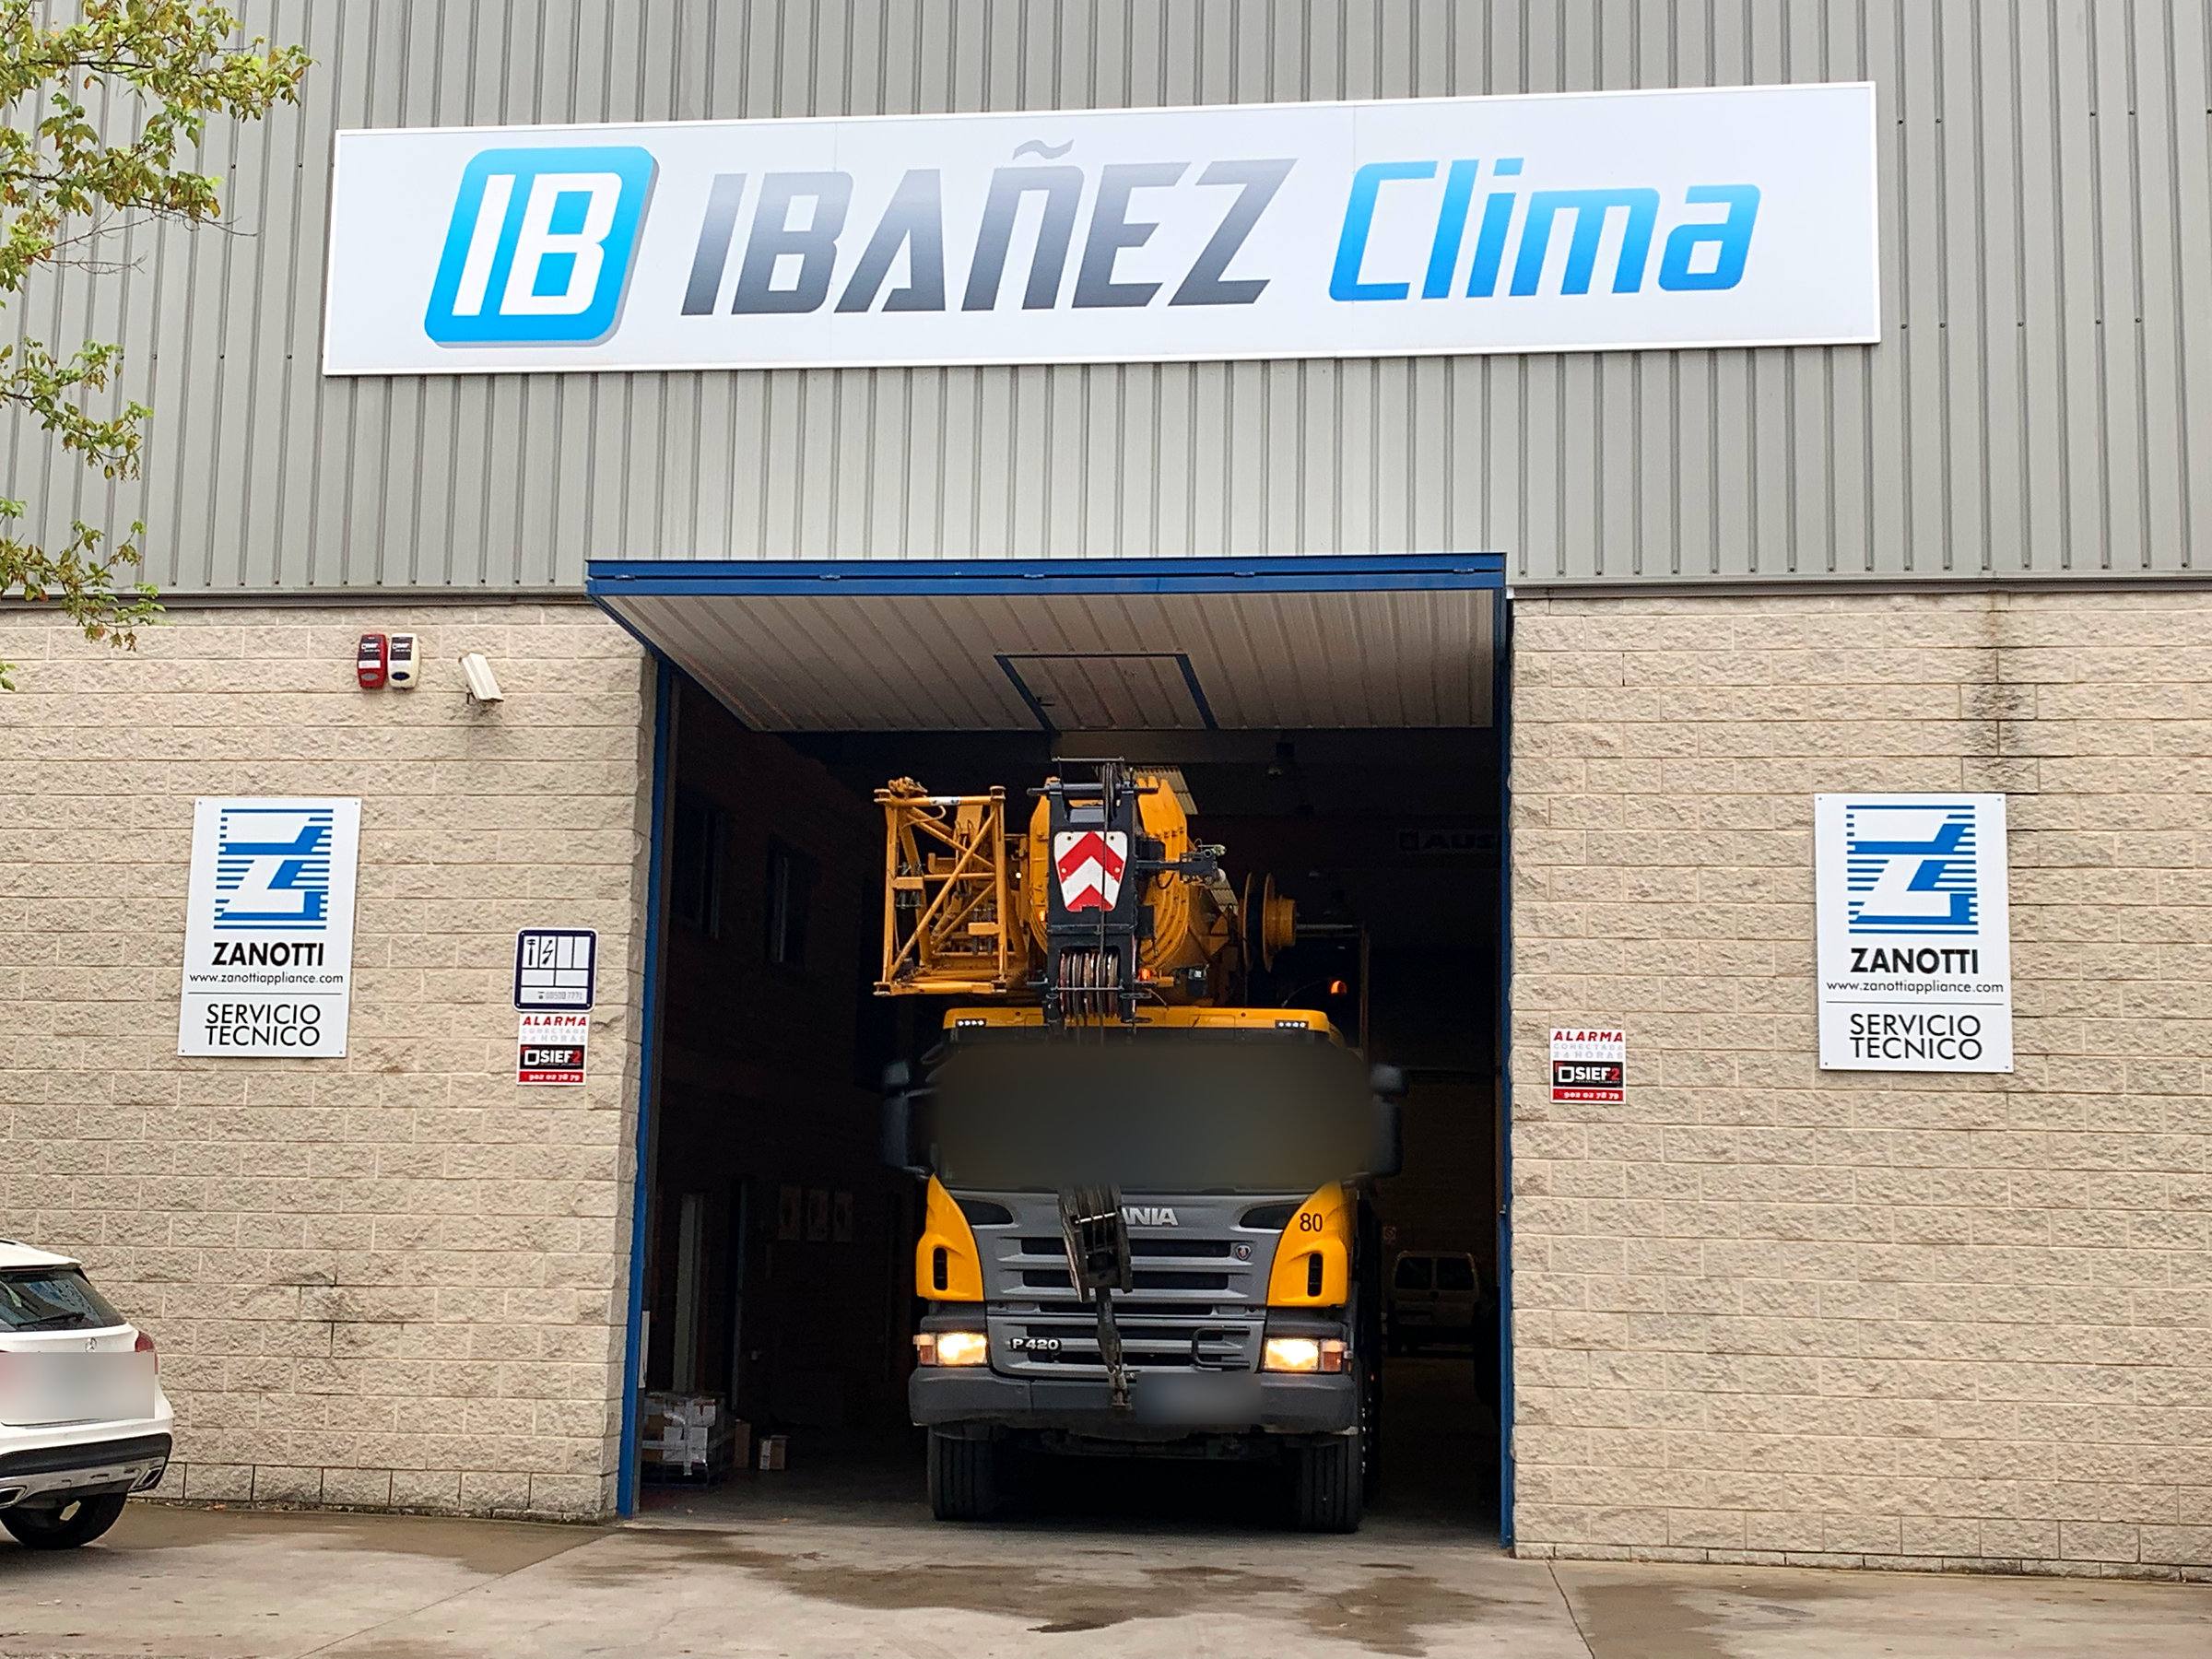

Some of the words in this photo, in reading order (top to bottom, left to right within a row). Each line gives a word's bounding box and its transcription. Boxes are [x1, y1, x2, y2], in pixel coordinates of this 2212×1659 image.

[680, 139, 1298, 316] IBAÑEZ
[1329, 158, 1761, 302] Clima
[452, 172, 623, 316] IB
[211, 942, 324, 967] ZANOTTI
[1850, 947, 1979, 975] ZANOTTI
[189, 971, 344, 985] www.zanottiappliance.com
[1826, 980, 2005, 994] www.zanottiappliance.com
[206, 1003, 321, 1025] SERVICIO
[523, 1016, 586, 1026] ALARMA
[1850, 1013, 1982, 1037] SERVICIO
[205, 1025, 321, 1047] TECNICO
[1553, 1030, 1623, 1041] ALARMA
[1849, 1037, 1983, 1061] TECNICO
[1300, 1212, 1323, 1232] 80
[1012, 1338, 1024, 1349] P
[1025, 1338, 1059, 1350] 420
